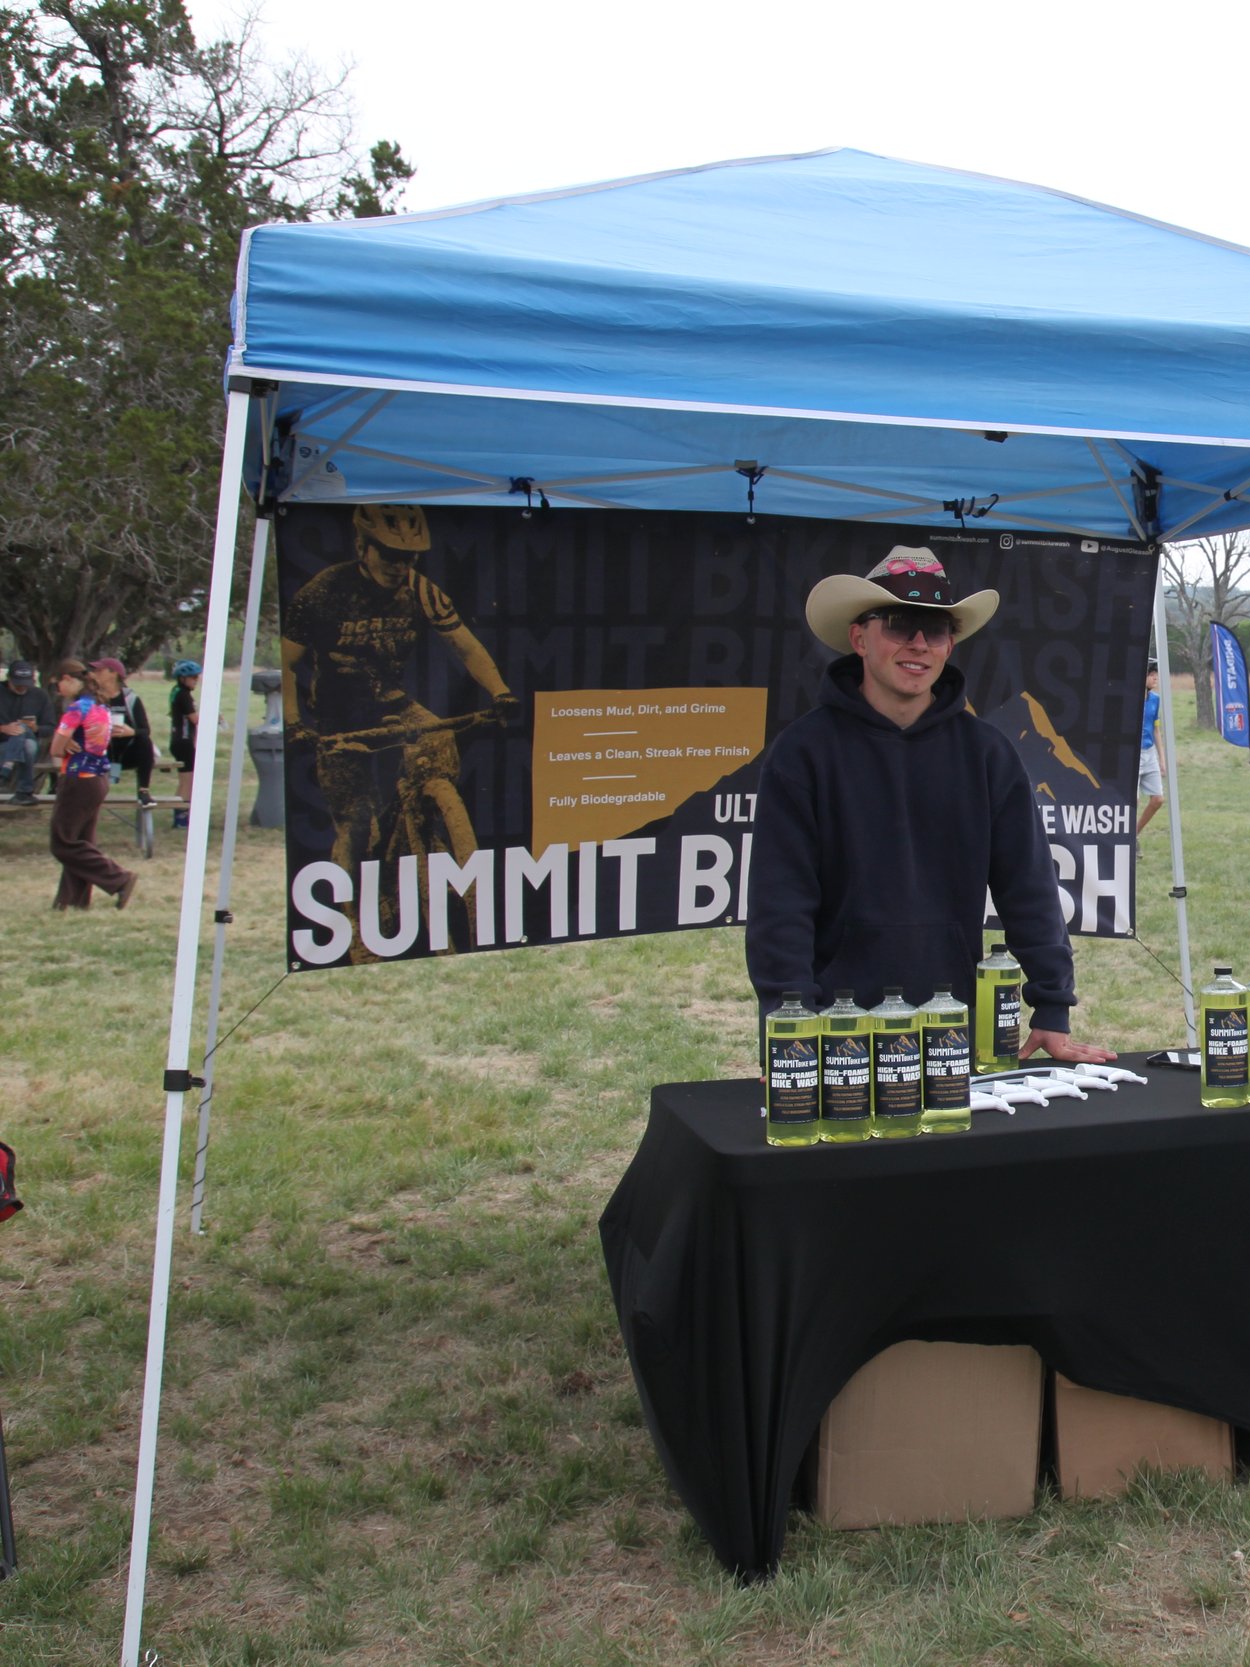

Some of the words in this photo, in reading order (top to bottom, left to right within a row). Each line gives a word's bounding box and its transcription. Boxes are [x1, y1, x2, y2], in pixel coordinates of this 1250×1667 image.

[551, 706, 602, 718] Loosens
[606, 705, 635, 716] Mud,
[638, 704, 662, 715] Dirt,
[665, 704, 687, 714] and
[690, 703, 726, 714] Grime
[549, 751, 592, 762] Leaves
[594, 752, 602, 760] a
[605, 748, 642, 760] Clean,
[646, 747, 682, 758] Streak
[686, 746, 711, 757] Free
[714, 746, 750, 756] Finish
[549, 796, 578, 808] Fully
[581, 792, 666, 806] Biodegradable
[1061, 805, 1130, 834] WASH
[291, 836, 656, 965] SUMMIT
[998, 1019, 1016, 1028] BIKE
[928, 1048, 953, 1056] SUMMIT
[880, 1054, 904, 1062] SUMMIT
[774, 1060, 799, 1068] SUMMIT
[824, 1076, 844, 1085] BIKE
[878, 1074, 898, 1082] BIKE
[772, 1079, 791, 1088] BIKE
